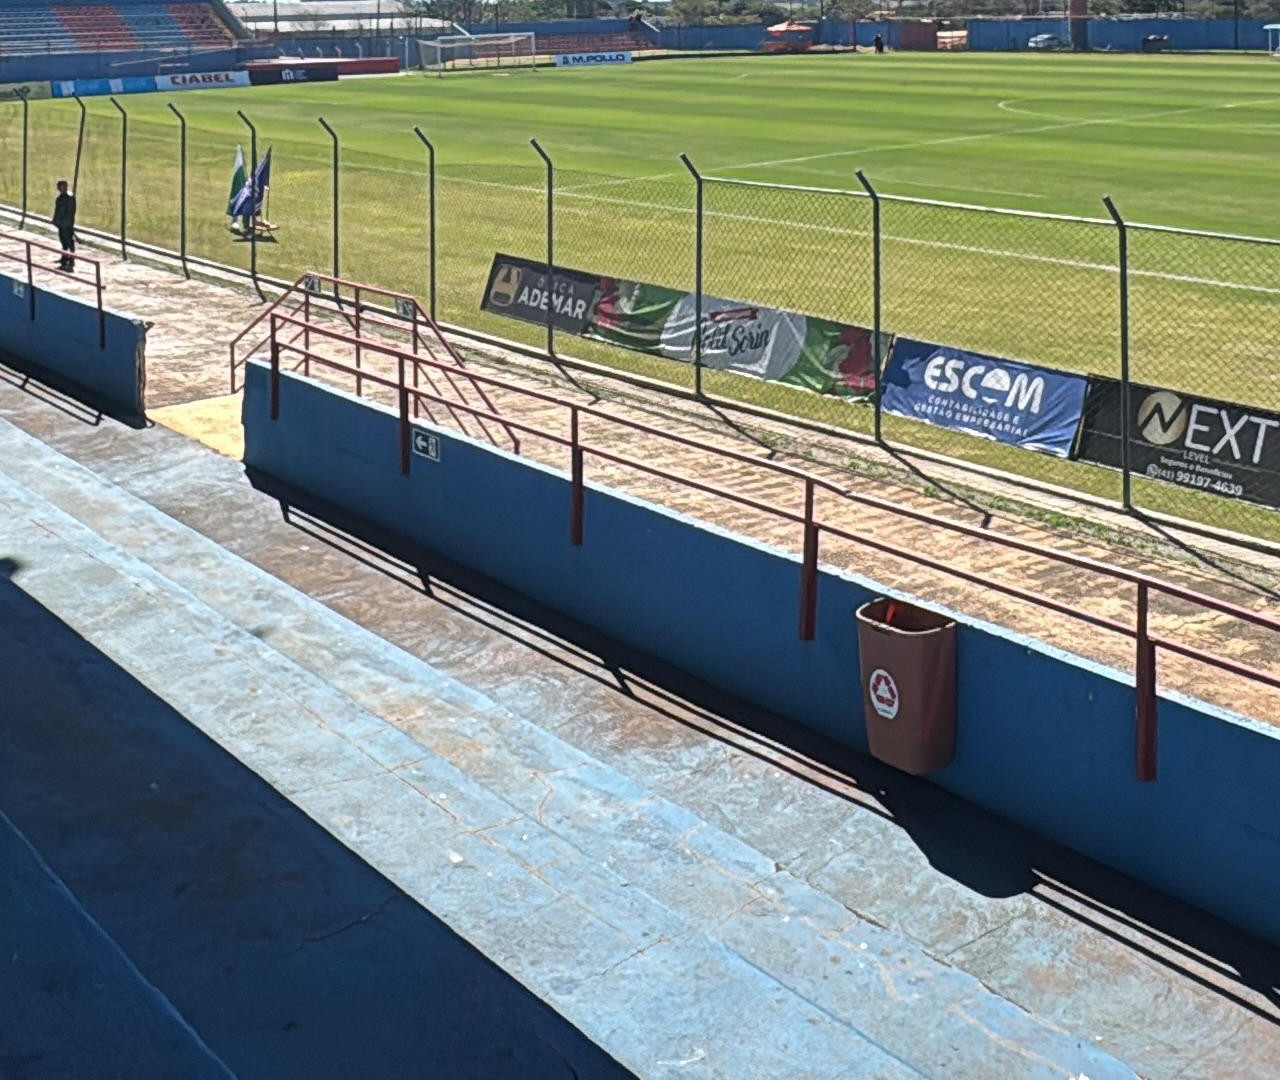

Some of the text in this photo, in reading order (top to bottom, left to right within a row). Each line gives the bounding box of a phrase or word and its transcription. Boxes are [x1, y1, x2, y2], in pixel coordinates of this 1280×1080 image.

[170, 72, 235, 86] CIABEL
[518, 286, 587, 320] ADEMAR
[924, 356, 1044, 414] ESCOM
[928, 395, 1020, 425] CONTABILIDADE E
[1182, 449, 1210, 465] LEVEL
